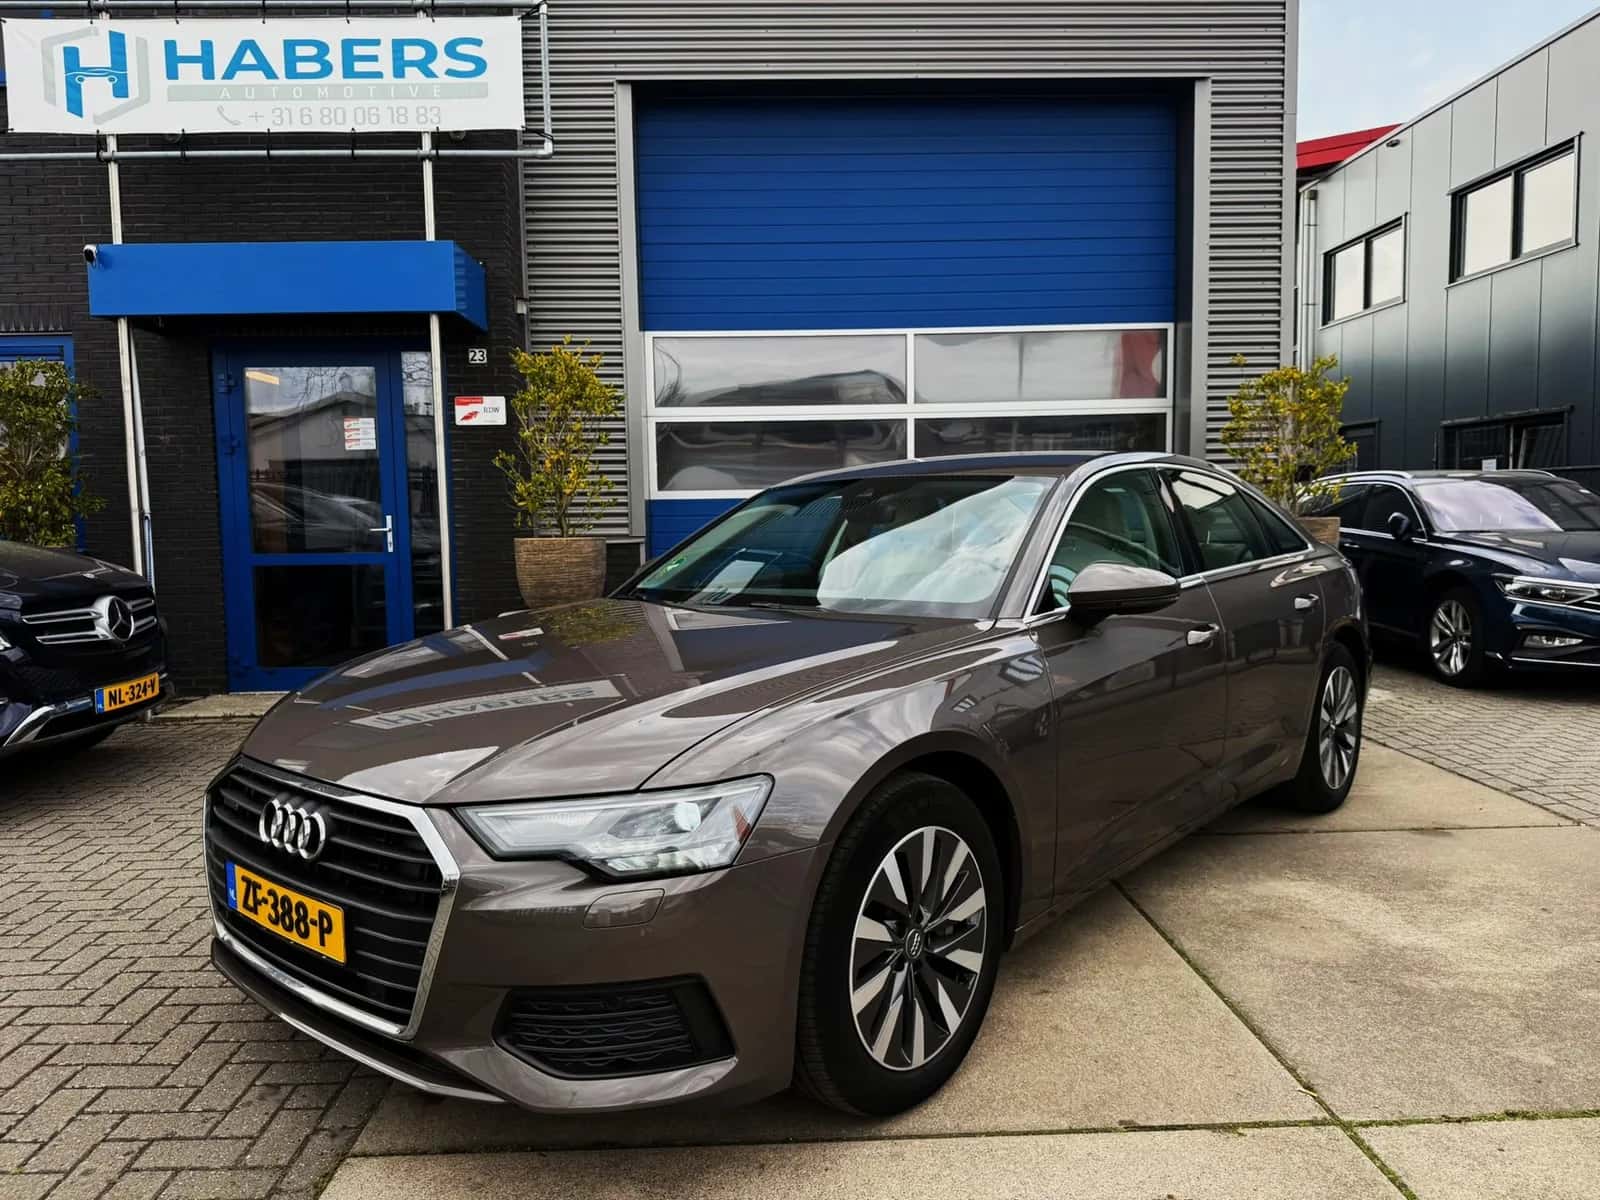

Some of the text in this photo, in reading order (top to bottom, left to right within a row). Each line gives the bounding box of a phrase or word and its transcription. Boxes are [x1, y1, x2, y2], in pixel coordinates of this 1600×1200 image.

[164, 37, 488, 80] HABERS
[219, 86, 441, 99] AUTOMOTIVE
[320, 107, 346, 126] 80
[353, 107, 381, 126] 06
[387, 106, 409, 126] 18
[415, 105, 441, 125] 83
[469, 350, 486, 362] 23
[108, 678, 156, 707] NL-324-V
[241, 875, 333, 947] ZF-388-P
